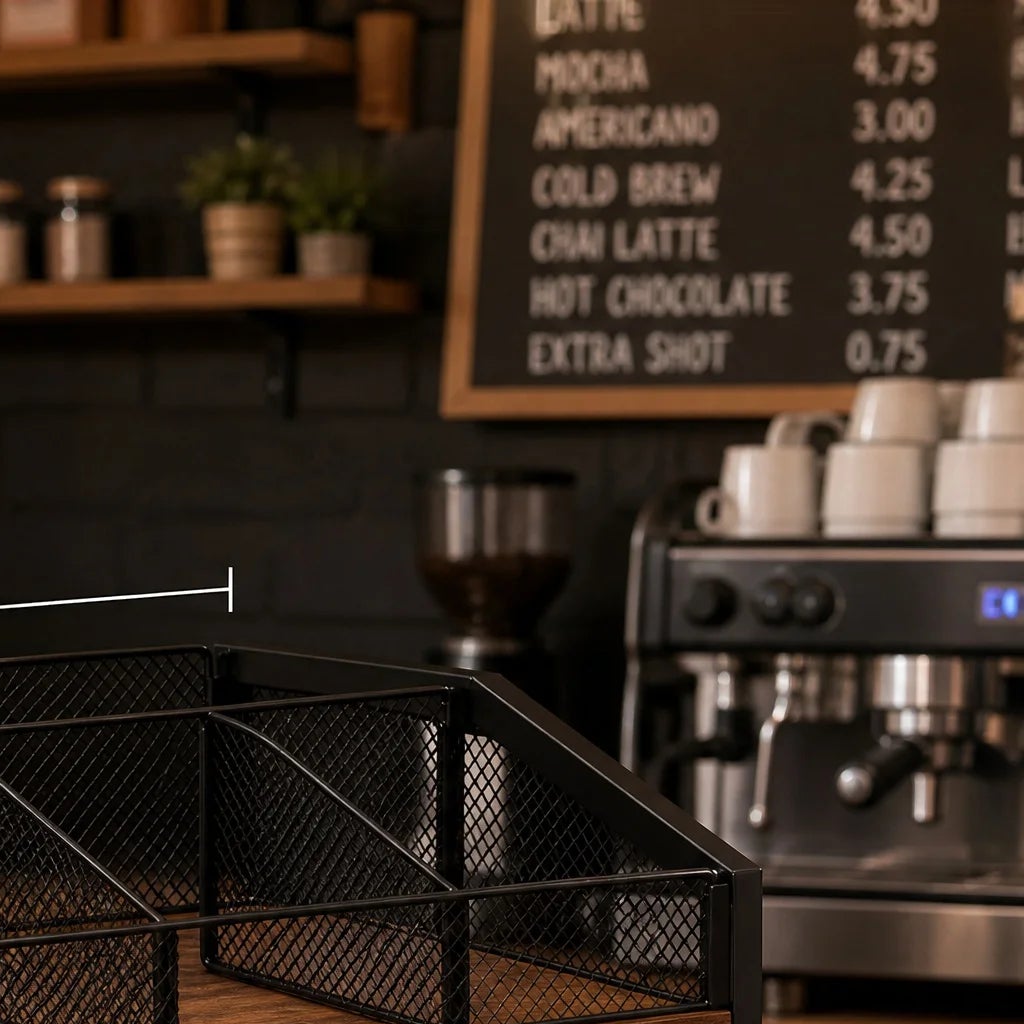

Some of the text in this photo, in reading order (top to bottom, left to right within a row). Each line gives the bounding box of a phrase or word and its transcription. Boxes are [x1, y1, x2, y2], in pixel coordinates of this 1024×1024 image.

[534, 41, 937, 94] MOCHA 4.75
[533, 99, 936, 148] AMERICANO 3.00
[531, 157, 933, 208] COLD BREW 4.25
[530, 213, 933, 262] CHAI LATTE 4.50
[529, 270, 929, 318] HOT CHOCOLATE 3.75
[527, 328, 928, 375] EXTRA SHOT 0.75
